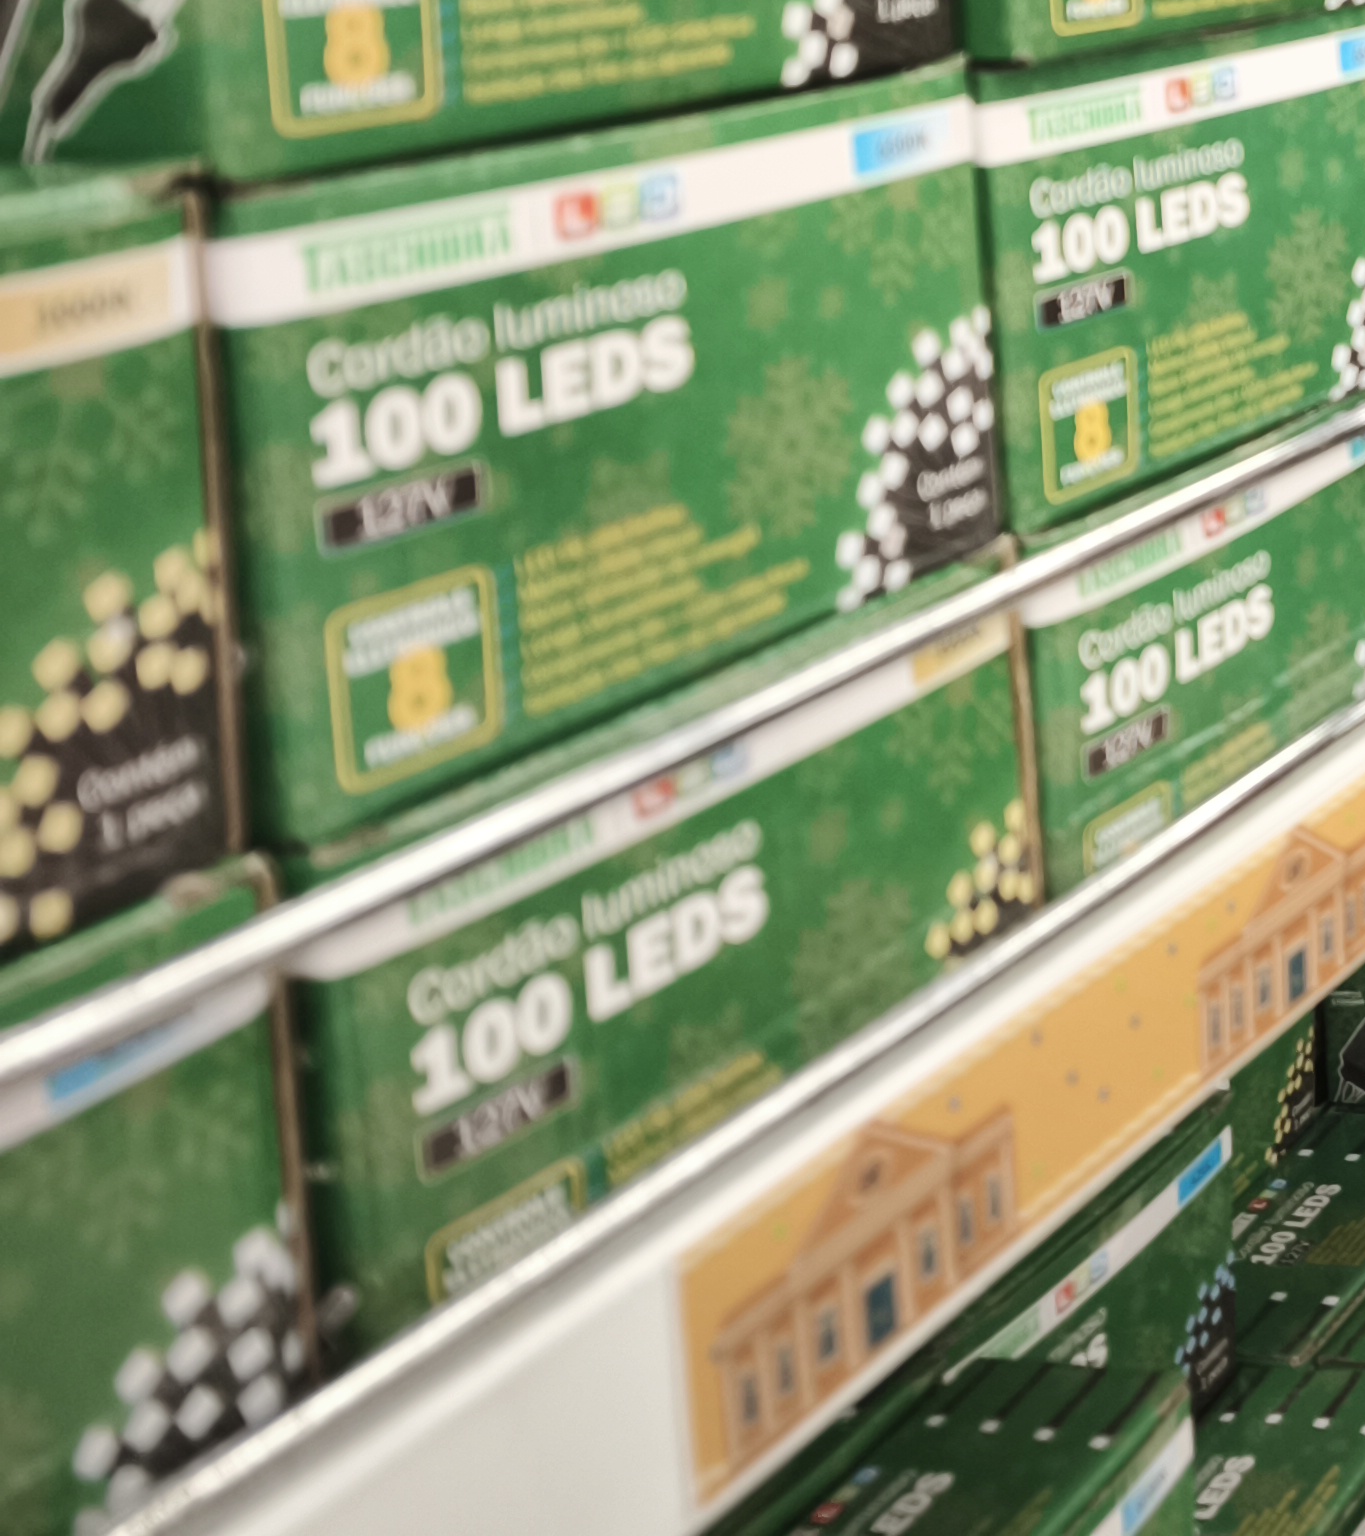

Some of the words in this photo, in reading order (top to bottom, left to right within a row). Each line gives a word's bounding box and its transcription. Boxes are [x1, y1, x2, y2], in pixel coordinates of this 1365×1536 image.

[1028, 162, 1134, 219] Cordão
[1132, 137, 1246, 193] luminoso
[1030, 204, 1132, 286] 100
[1134, 171, 1251, 255] LEDS
[305, 314, 490, 399] Cordão
[492, 268, 689, 354] luminoso
[309, 371, 483, 490] 100
[495, 314, 696, 439] LEDS
[1078, 601, 1174, 672] Cordão
[1172, 548, 1272, 624] luminoso
[1080, 642, 1171, 735] 100
[1173, 583, 1276, 686] LEDS
[407, 910, 579, 1027] Cordão
[581, 817, 763, 939] luminoso
[409, 972, 575, 1119] 100
[582, 863, 770, 1023] LEDS
[1250, 1230, 1298, 1266] 100
[1282, 1183, 1342, 1229] LEDS
[1194, 1455, 1256, 1521] LEDS
